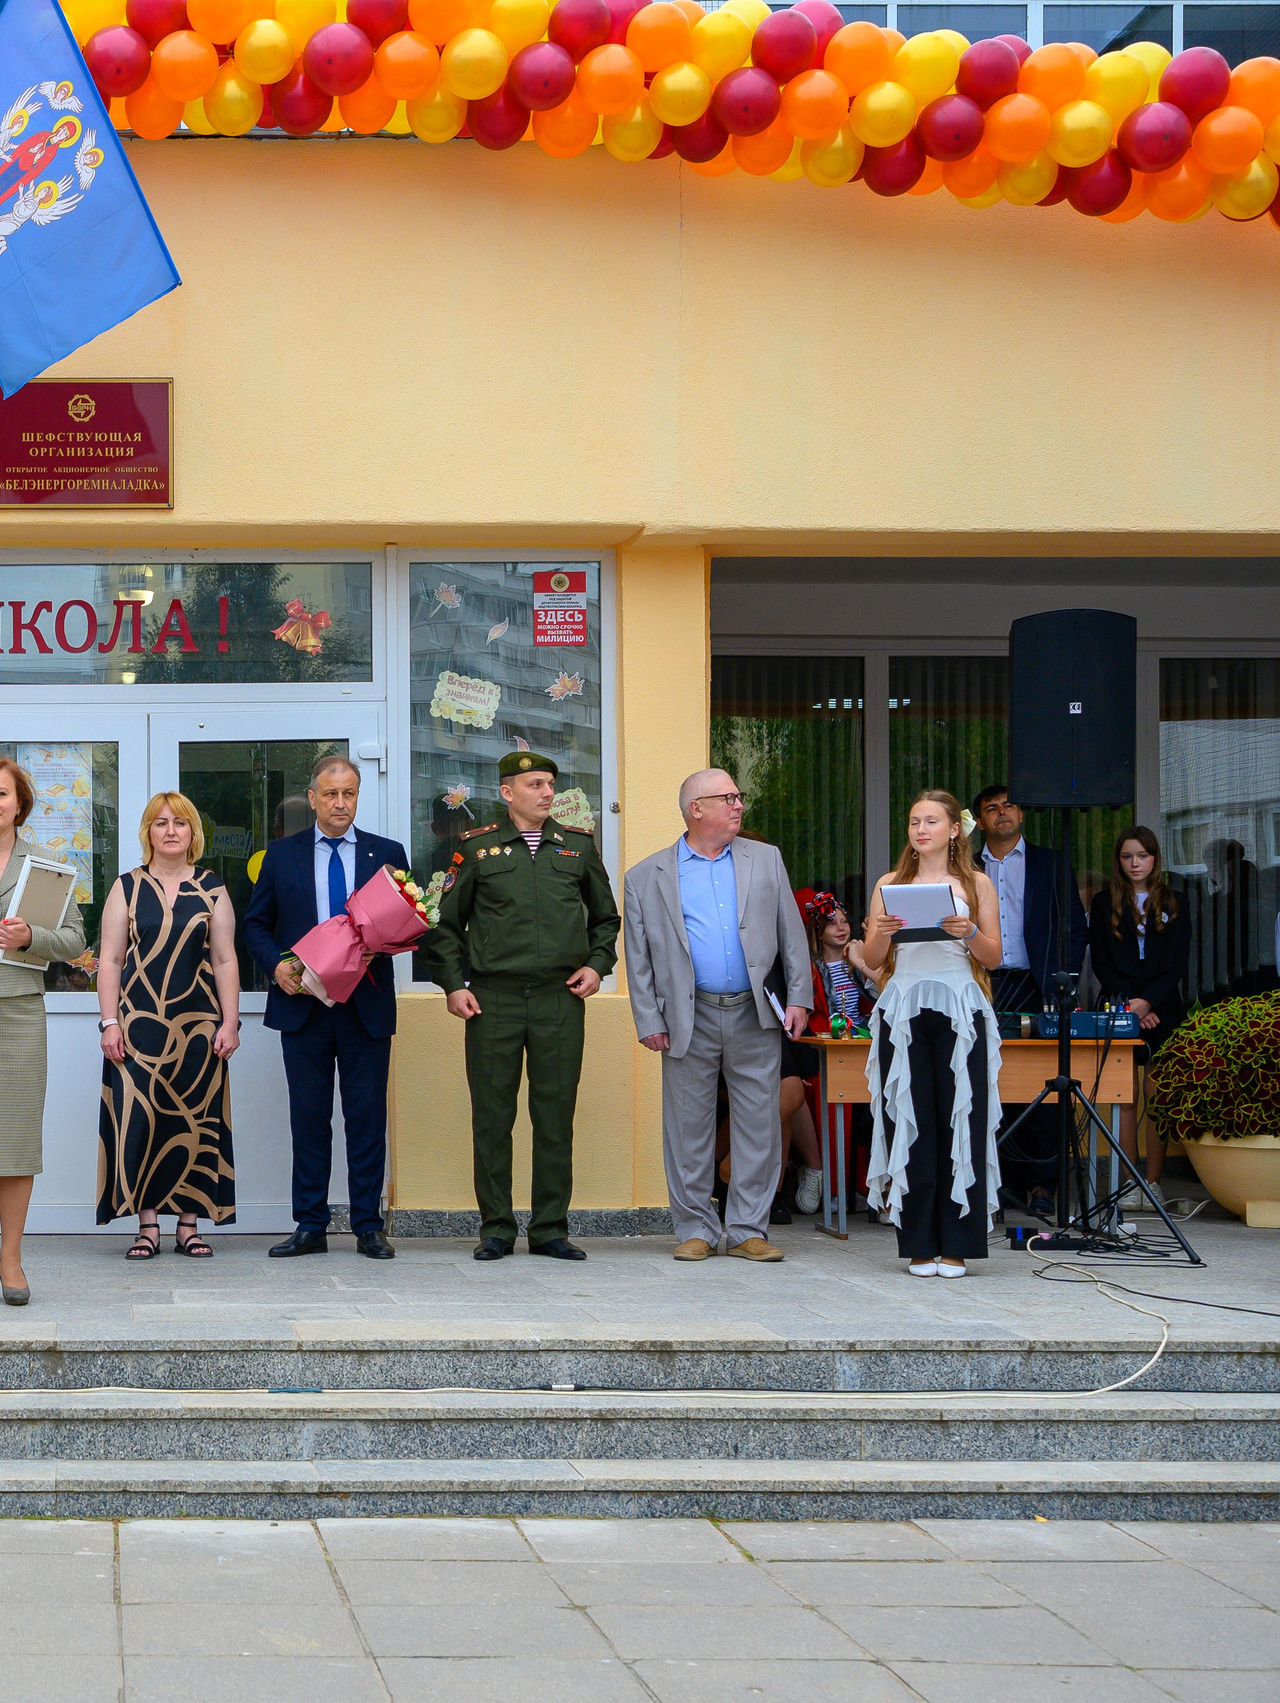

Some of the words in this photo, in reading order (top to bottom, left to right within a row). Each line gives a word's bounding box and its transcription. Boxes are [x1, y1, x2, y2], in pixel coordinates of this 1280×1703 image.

[22, 432, 142, 444] ШЕФСТВУЮЩАЯ
[29, 447, 134, 458] ОРГАНИЗАЦИЯ
[0, 480, 165, 492] «БЕЛЭНЕРГОРЕМНАЛАДКА»
[537, 611, 583, 624] ЗДЕСЬ
[537, 635, 584, 643] МИЛИЦИЮ
[447, 675, 486, 695] Вперёд
[445, 689, 490, 706] знаниям!
[552, 802, 581, 820] колу!
